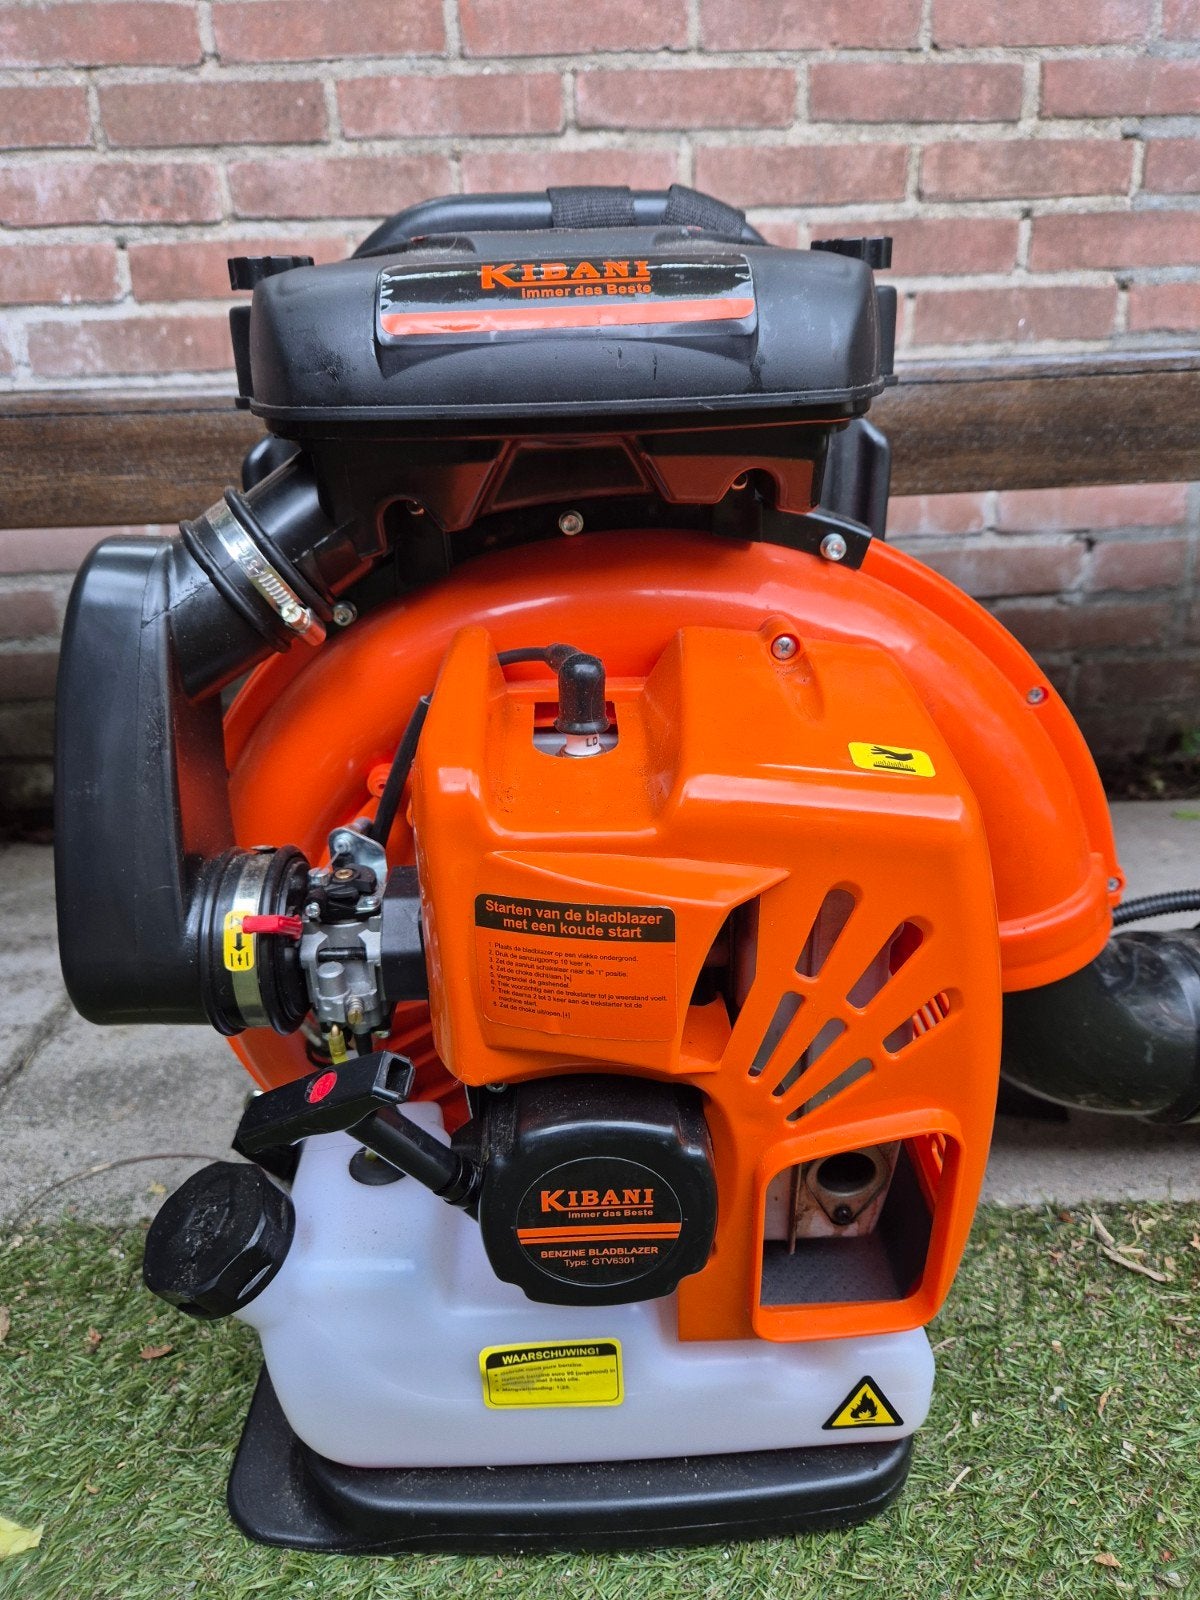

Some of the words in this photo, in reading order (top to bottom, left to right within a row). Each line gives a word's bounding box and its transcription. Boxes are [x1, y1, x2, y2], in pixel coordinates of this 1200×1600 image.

[481, 260, 652, 289] KIBANI
[575, 285, 603, 296] das
[606, 283, 652, 295] Beste
[485, 899, 532, 917] Starten
[535, 908, 560, 920] van
[564, 908, 582, 922] de
[586, 909, 663, 926] bladblazer
[503, 917, 528, 931] met
[531, 921, 556, 934] een
[560, 922, 603, 938] koude
[608, 926, 642, 939] start
[600, 954, 639, 962] ondergrond.
[541, 1188, 654, 1213] KIBANI
[603, 1209, 621, 1217] das
[624, 1208, 654, 1217] Beste
[541, 1249, 586, 1258] BENZINE
[588, 1246, 659, 1256] BLADBLAZER
[564, 1259, 589, 1268] Type:
[592, 1257, 635, 1266] GTV6301
[501, 1347, 600, 1365] WAARSCHUWING!
